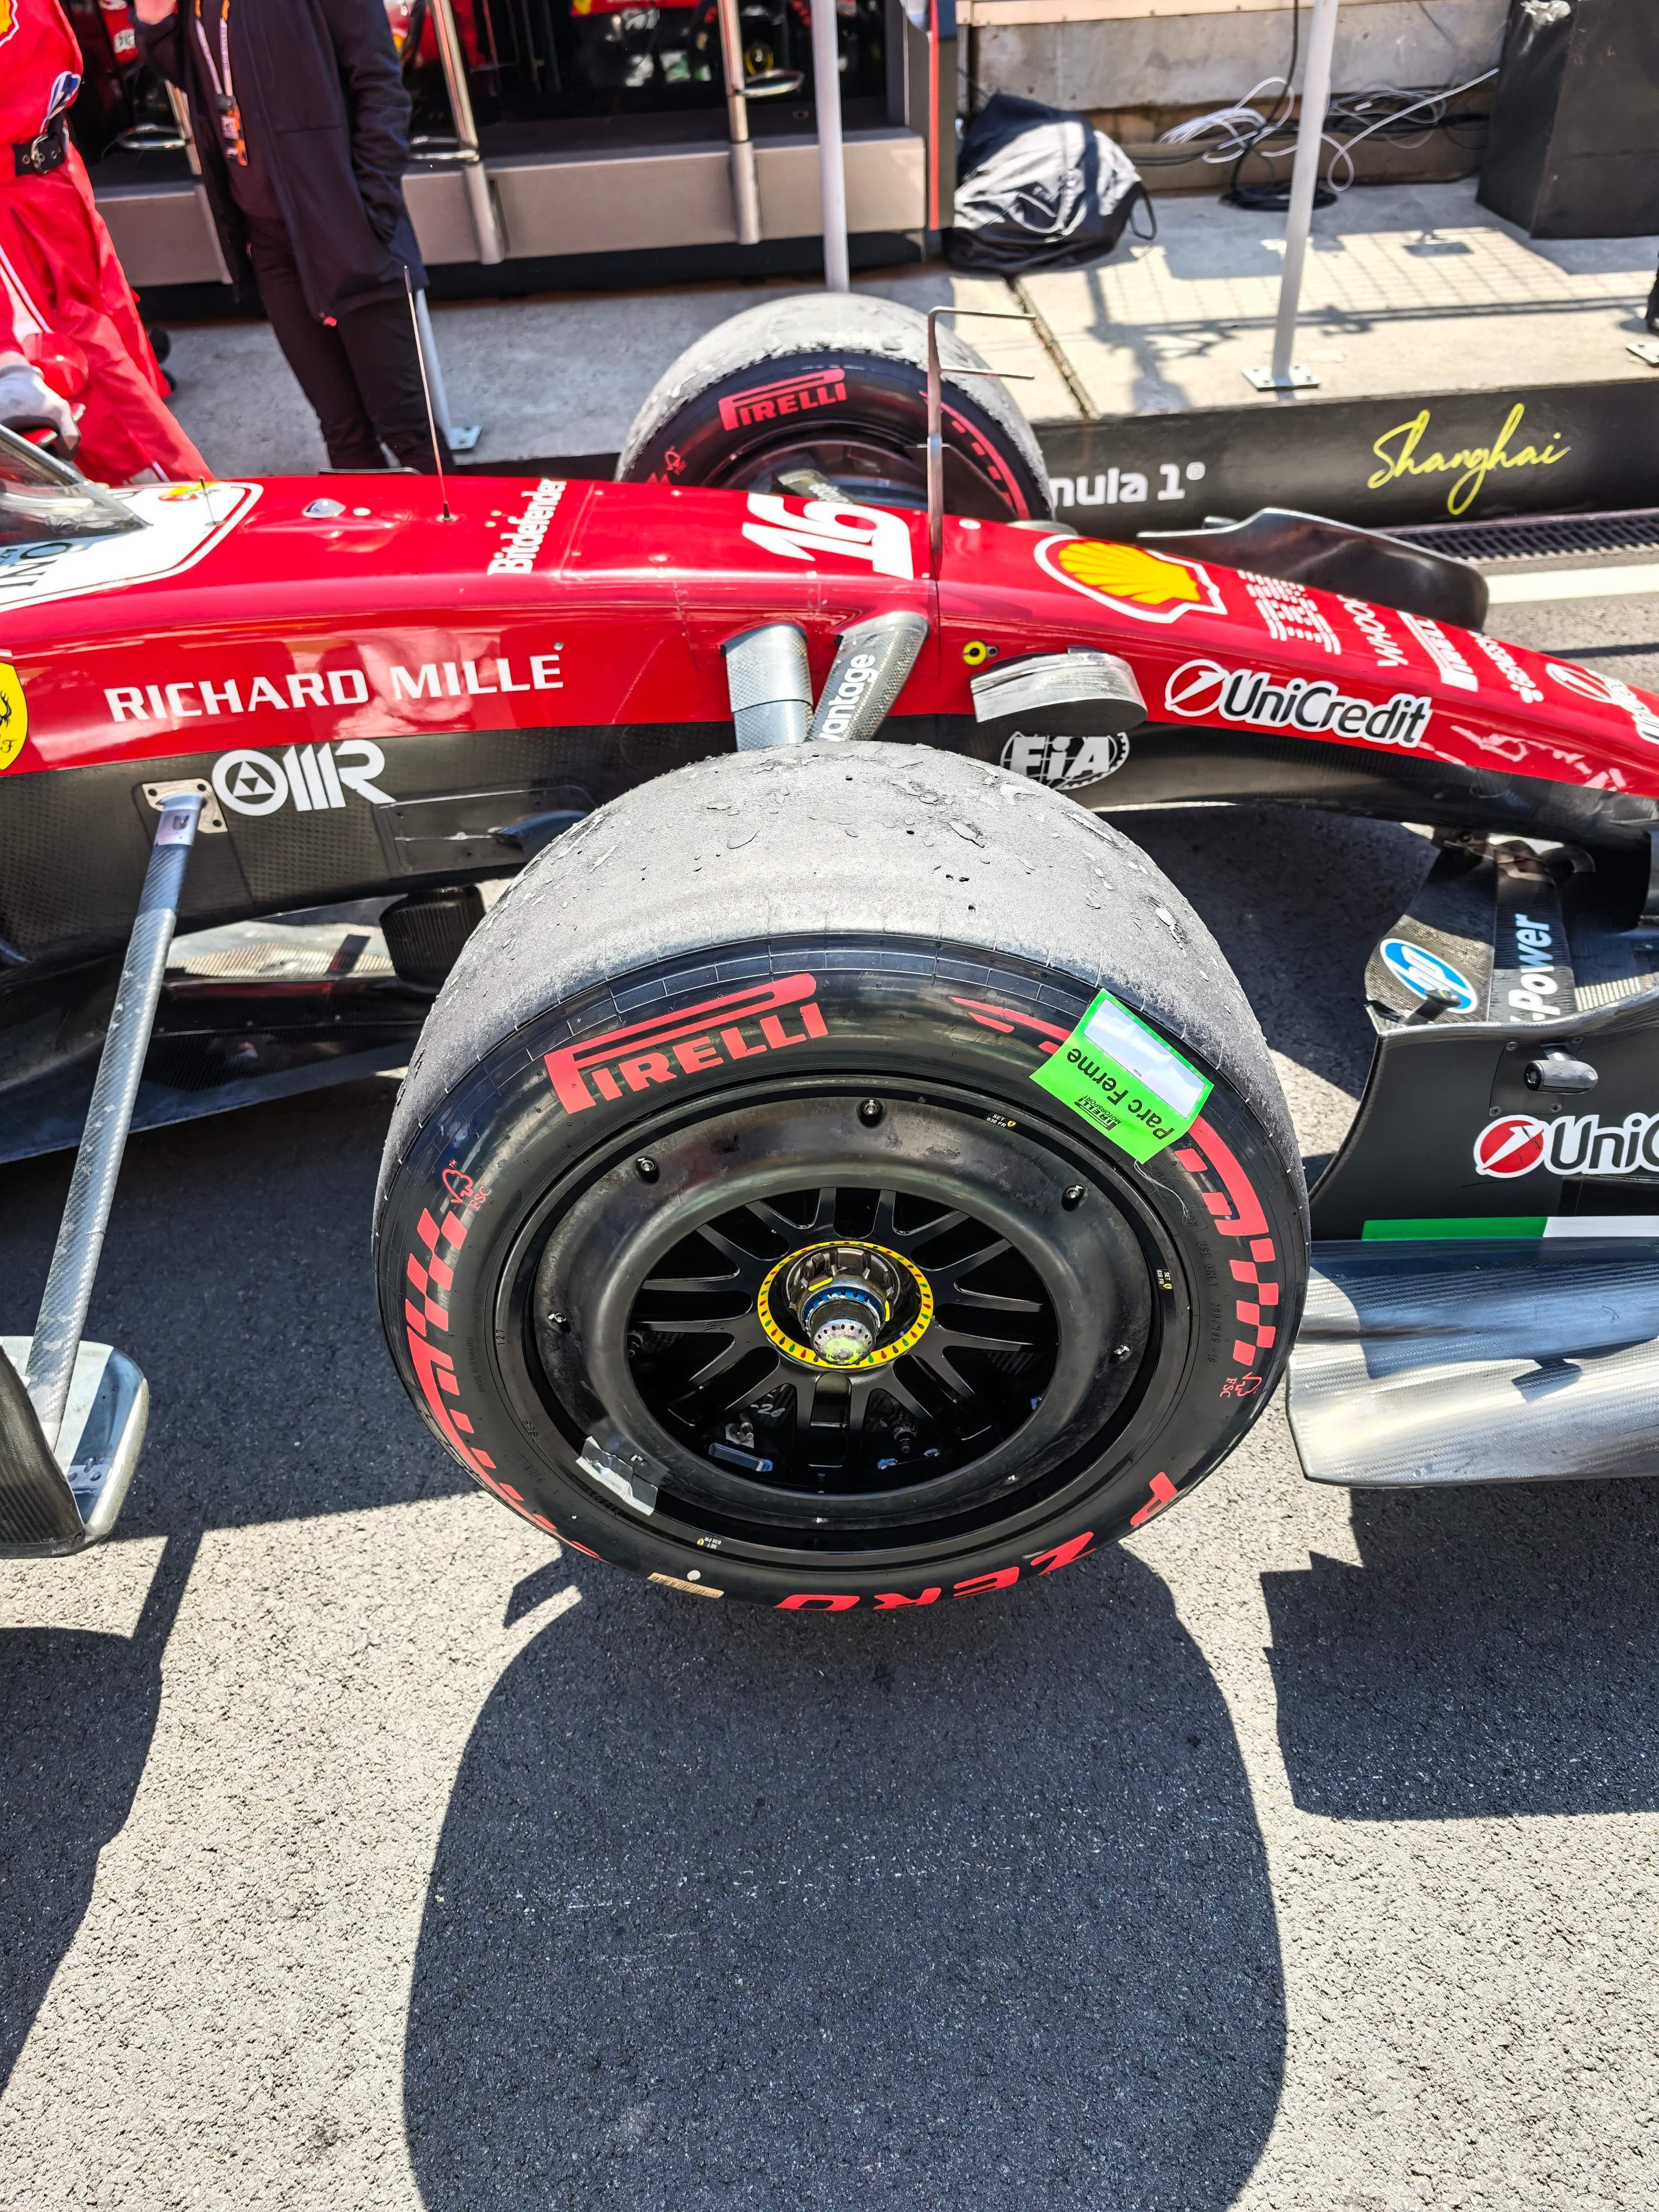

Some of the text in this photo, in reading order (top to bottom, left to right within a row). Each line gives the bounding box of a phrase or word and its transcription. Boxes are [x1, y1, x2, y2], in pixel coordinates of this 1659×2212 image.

[718, 368, 847, 431] PIRELLI
[1367, 402, 1572, 516] Shanghai
[487, 478, 568, 576] Bitdefender
[741, 492, 914, 581] 16
[104, 654, 564, 723] RICHARD MILLE
[1395, 610, 1479, 692] PIRELL
[1220, 673, 1429, 745] UniCredit
[1508, 913, 1561, 1022] -Power
[544, 973, 829, 1115] PIRELLI
[1067, 1048, 1175, 1141] Parc Ferme
[1074, 1097, 1118, 1131] PIRELLI
[1082, 1095, 1123, 1124] MOTORSPORT
[468, 1185, 492, 1211] FSC
[1219, 1377, 1238, 1398] FSC
[773, 1471, 1178, 1611] P ZERO
